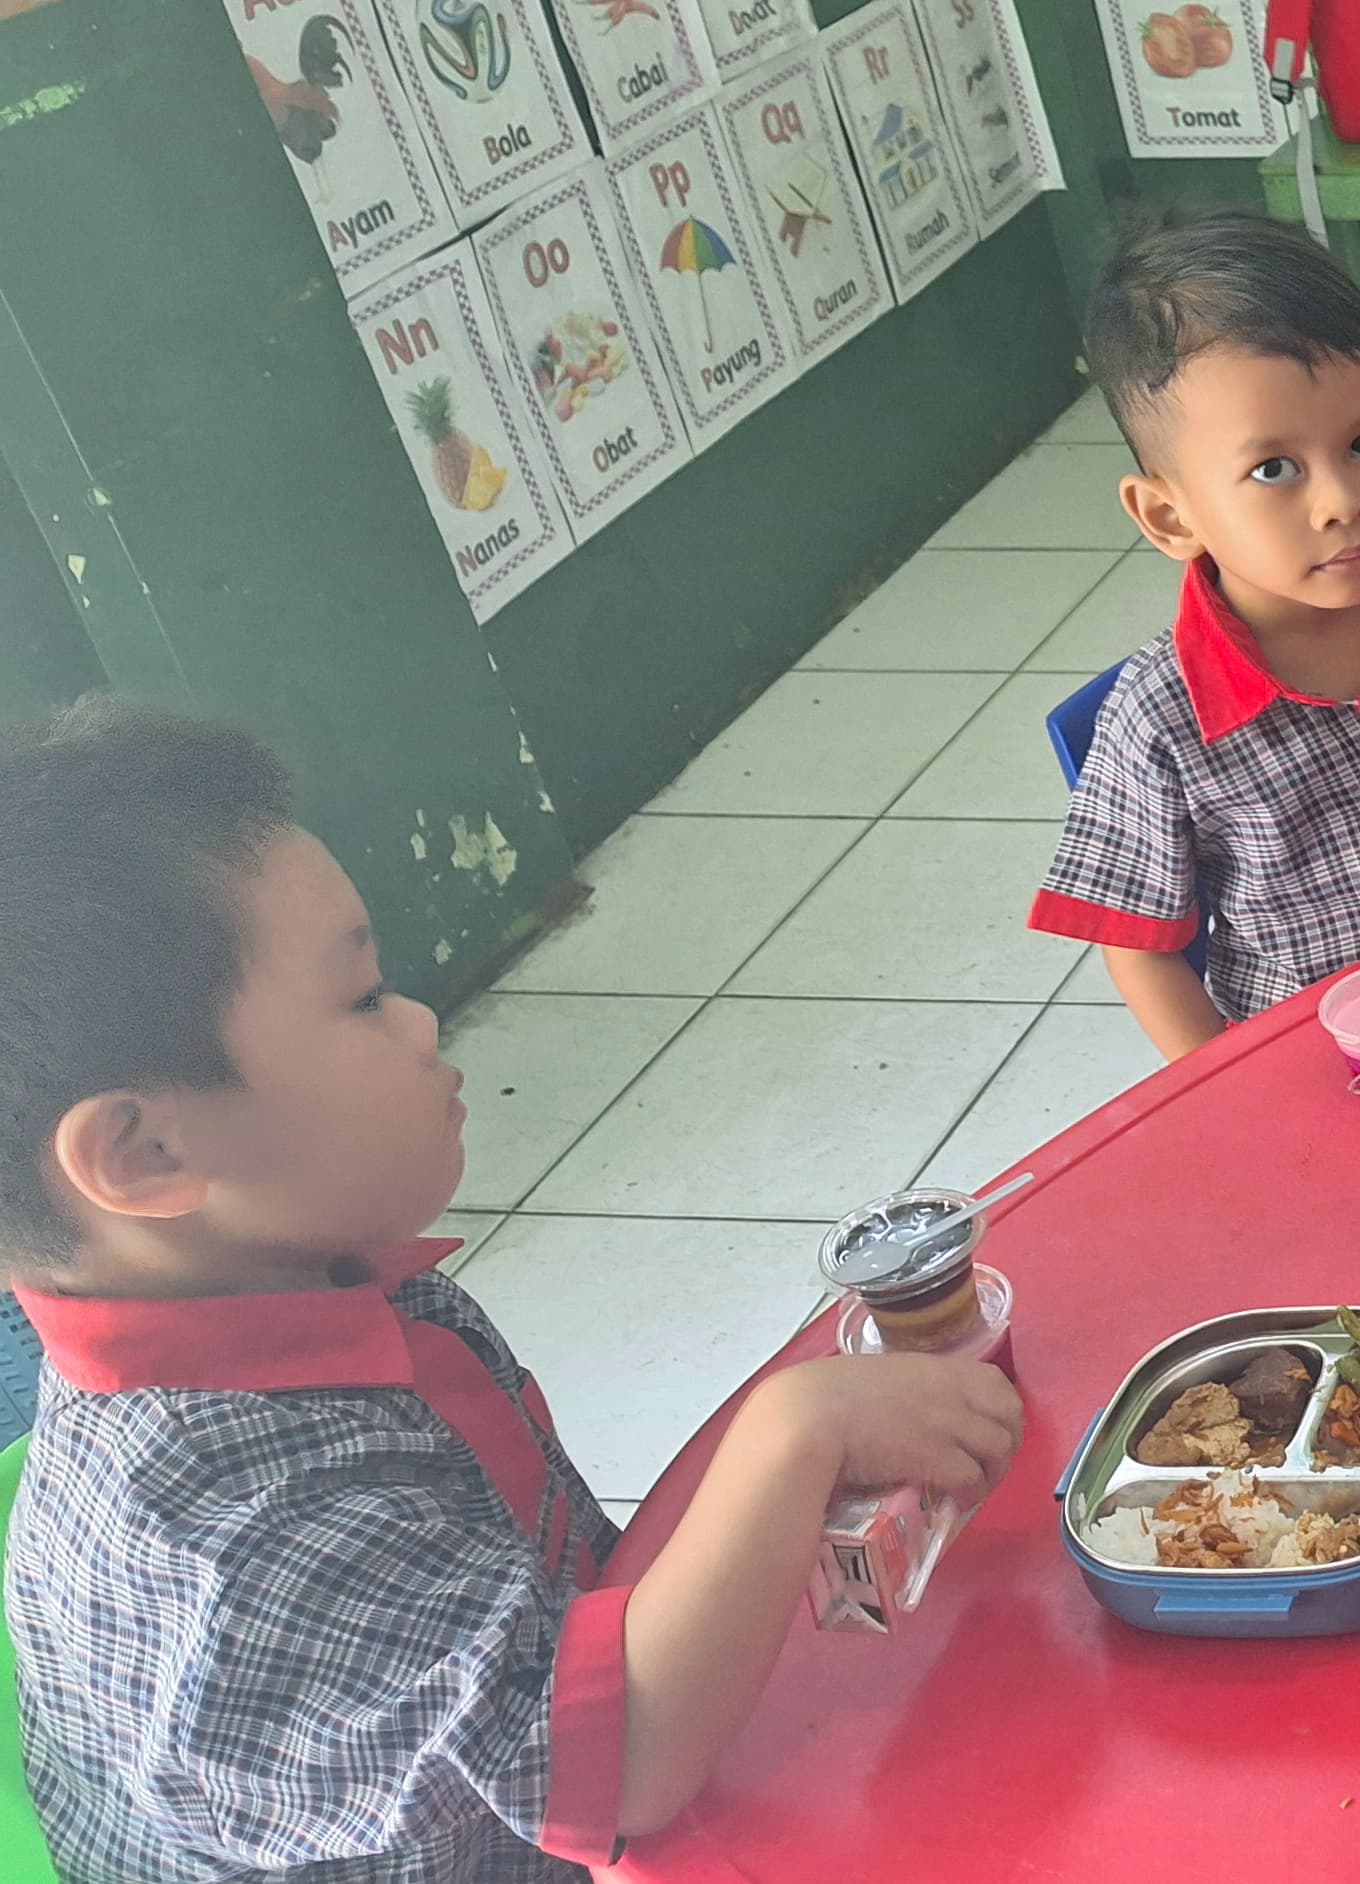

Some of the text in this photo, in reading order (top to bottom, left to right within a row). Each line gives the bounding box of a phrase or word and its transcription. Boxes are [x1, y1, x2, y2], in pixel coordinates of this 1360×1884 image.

[616, 54, 669, 102] Cabai
[863, 45, 888, 85] Rr
[761, 100, 805, 145] Qq
[1165, 107, 1242, 128] Tomat
[482, 123, 532, 166] Bola
[649, 160, 691, 208] Pp
[326, 198, 395, 252] Ayam
[904, 208, 950, 256] Rumah
[522, 237, 570, 289] Oo
[813, 277, 858, 321] Quran
[375, 317, 440, 375] Nn
[700, 337, 762, 393] Payung
[592, 425, 639, 473] Obat
[455, 516, 521, 578] Nanas
